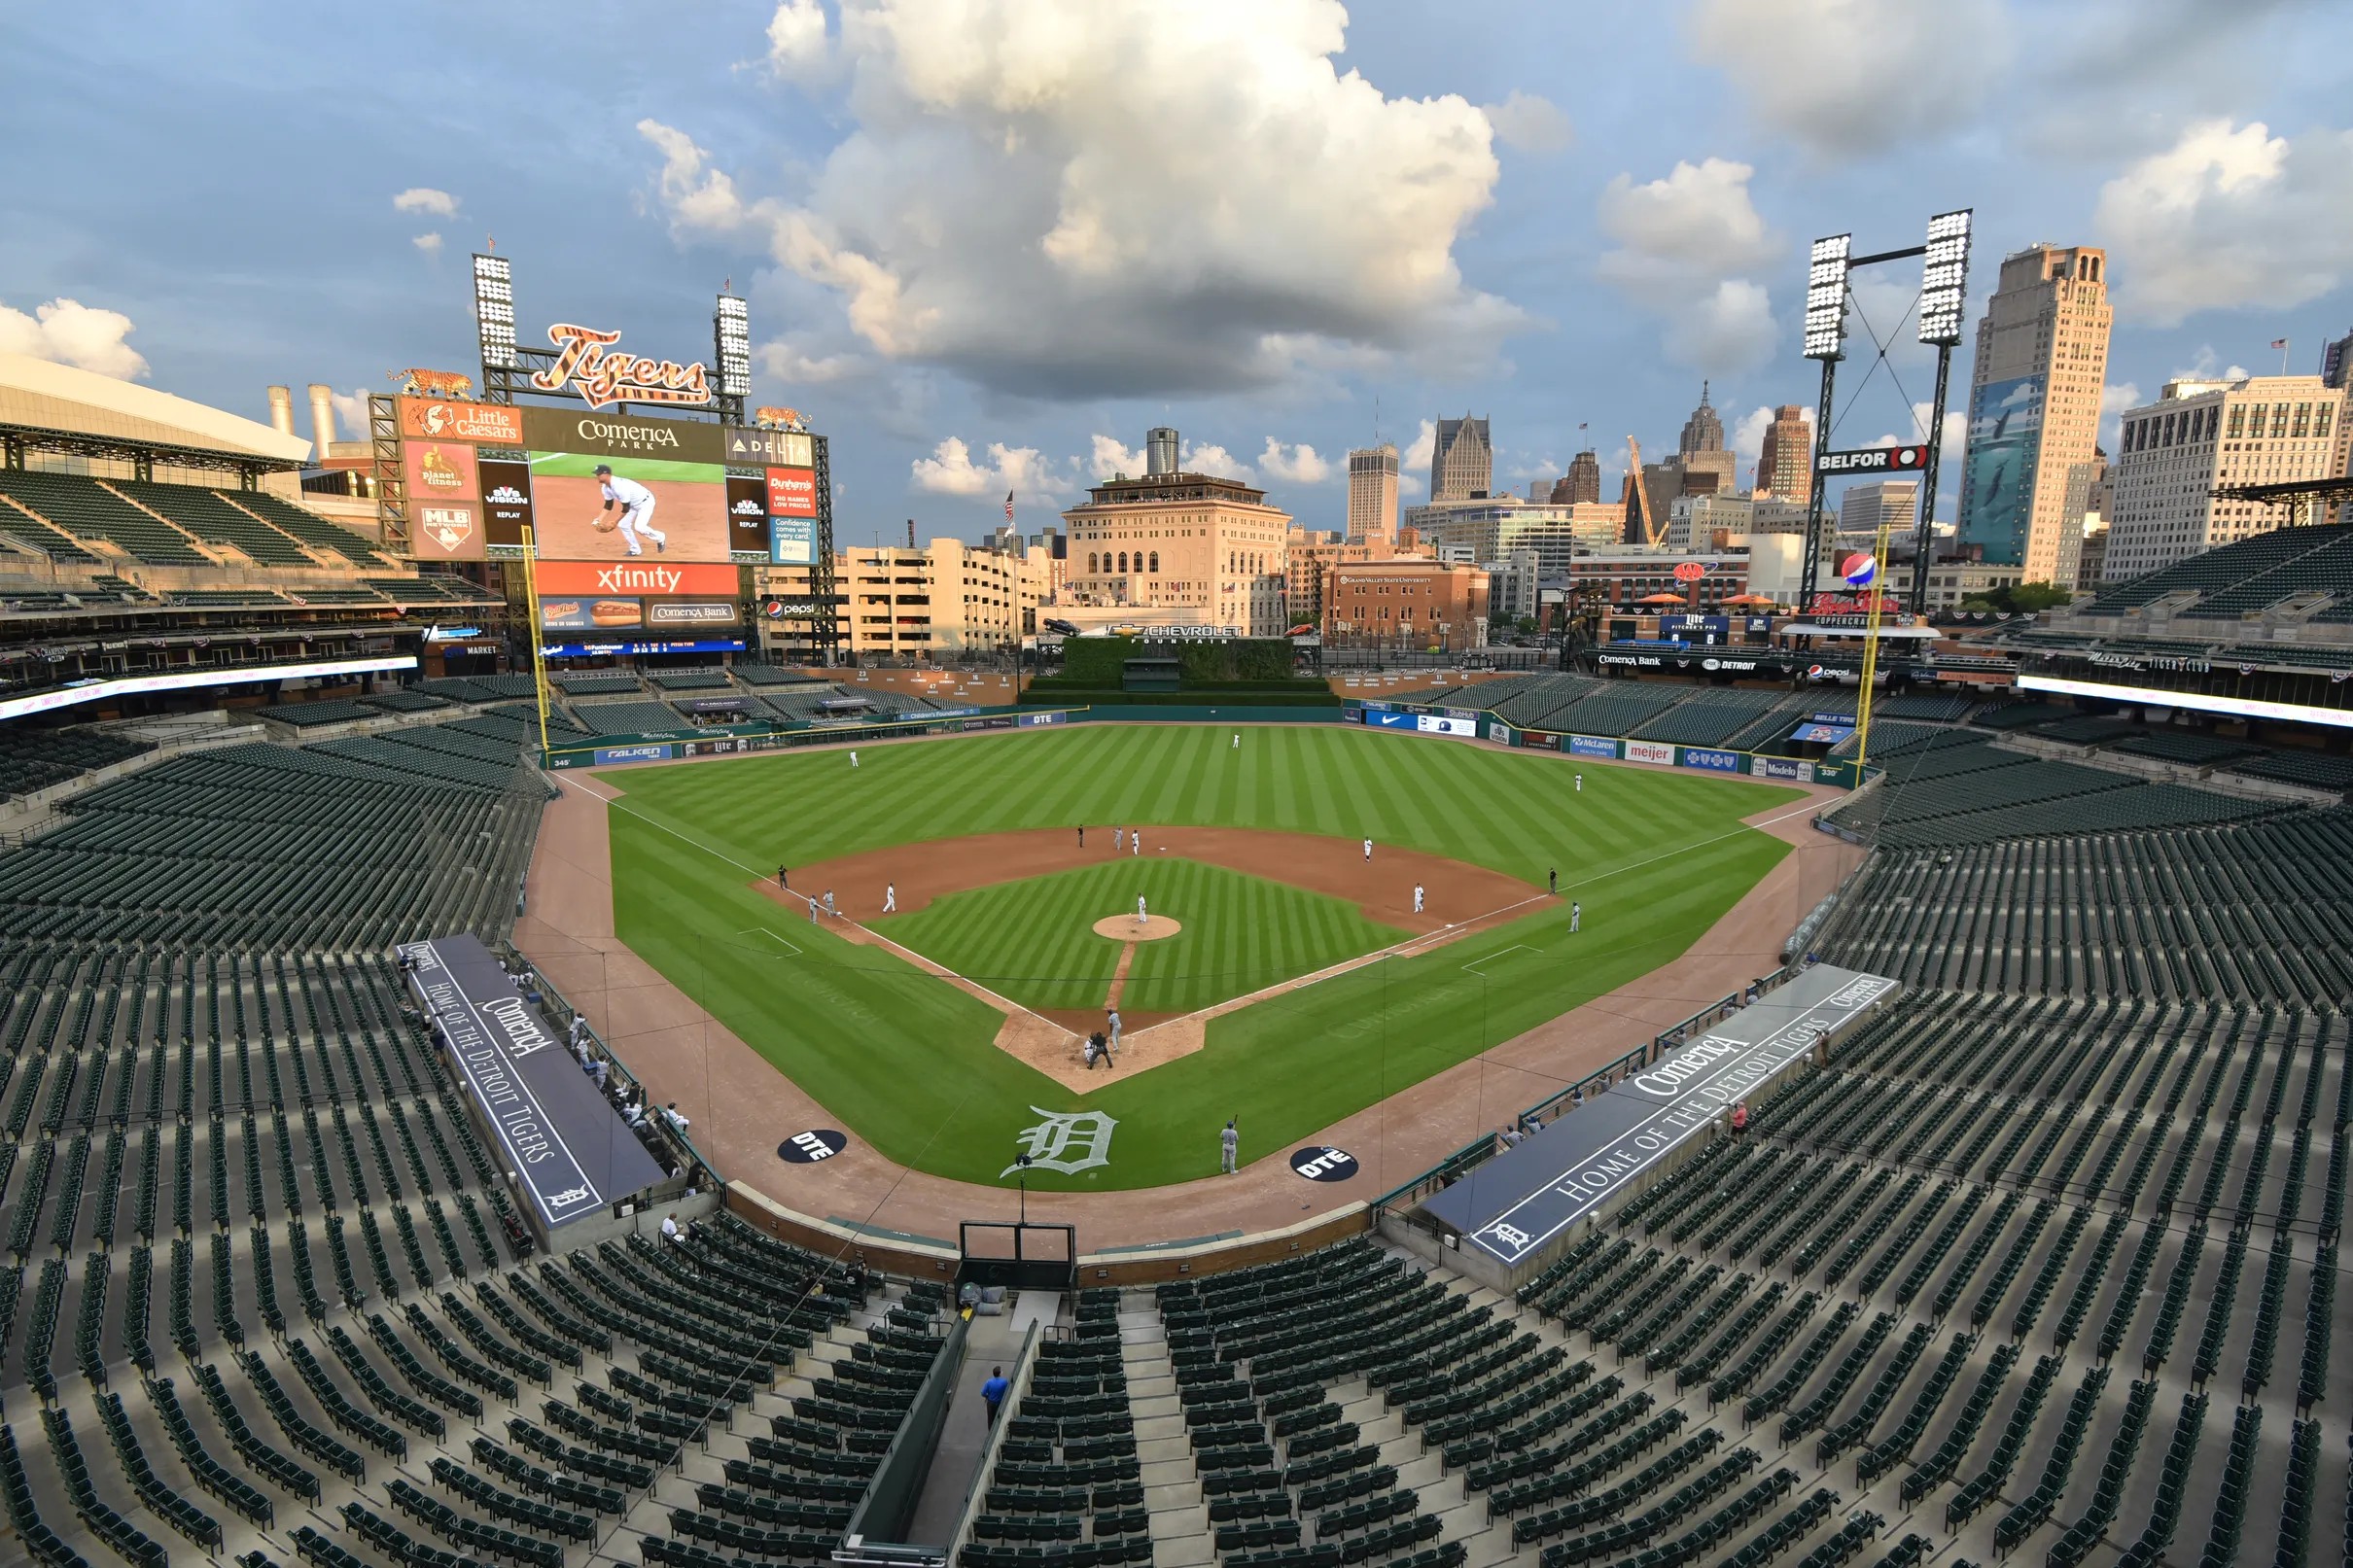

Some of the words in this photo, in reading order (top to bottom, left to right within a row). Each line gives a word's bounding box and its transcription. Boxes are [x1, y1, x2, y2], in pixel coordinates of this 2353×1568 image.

[532, 324, 712, 410] Tigers
[468, 408, 509, 426] Little
[456, 419, 517, 438] Caesars
[608, 439, 654, 450] PARK
[751, 440, 807, 455] DELTA
[1818, 452, 1887, 470] BELFOR
[422, 470, 455, 480] planet
[428, 477, 462, 487] fitness
[485, 496, 528, 505] VISION
[425, 509, 469, 524] MLB
[1677, 563, 1703, 580] AAA
[596, 564, 683, 593] xfinity
[704, 607, 728, 616] Bank
[784, 604, 814, 615] pepsi
[1685, 613, 1704, 626] Lite
[1148, 625, 1243, 638] CHEVROLET
[467, 645, 497, 655] MARKET
[1638, 657, 1661, 666] Bank
[1721, 660, 1757, 670] DETROIT
[2149, 659, 2176, 670] TIGER
[2186, 661, 2210, 673] CLUB
[1034, 714, 1052, 724] DTE
[1449, 710, 1475, 718] StubHub
[1491, 734, 1508, 744] VISION
[1583, 739, 1614, 749] McLaren
[608, 748, 661, 757] FALKEN
[715, 742, 732, 752] Lite
[1631, 745, 1668, 760] meijer
[1768, 764, 1797, 776] Modelo
[428, 982, 460, 1010] HOME
[444, 1011, 469, 1028] OF
[453, 1026, 484, 1049] THE
[468, 1049, 522, 1106] DETROIT
[1555, 1149, 1641, 1202] HOME
[1634, 1127, 1670, 1150] OF
[1662, 1099, 1712, 1128] THE
[1699, 1050, 1781, 1101] DETROIT
[1769, 1017, 1830, 1051] TIGERS
[503, 1105, 555, 1164] TIGERS
[790, 1132, 835, 1161] DTE
[1296, 1149, 1352, 1178] DTE
